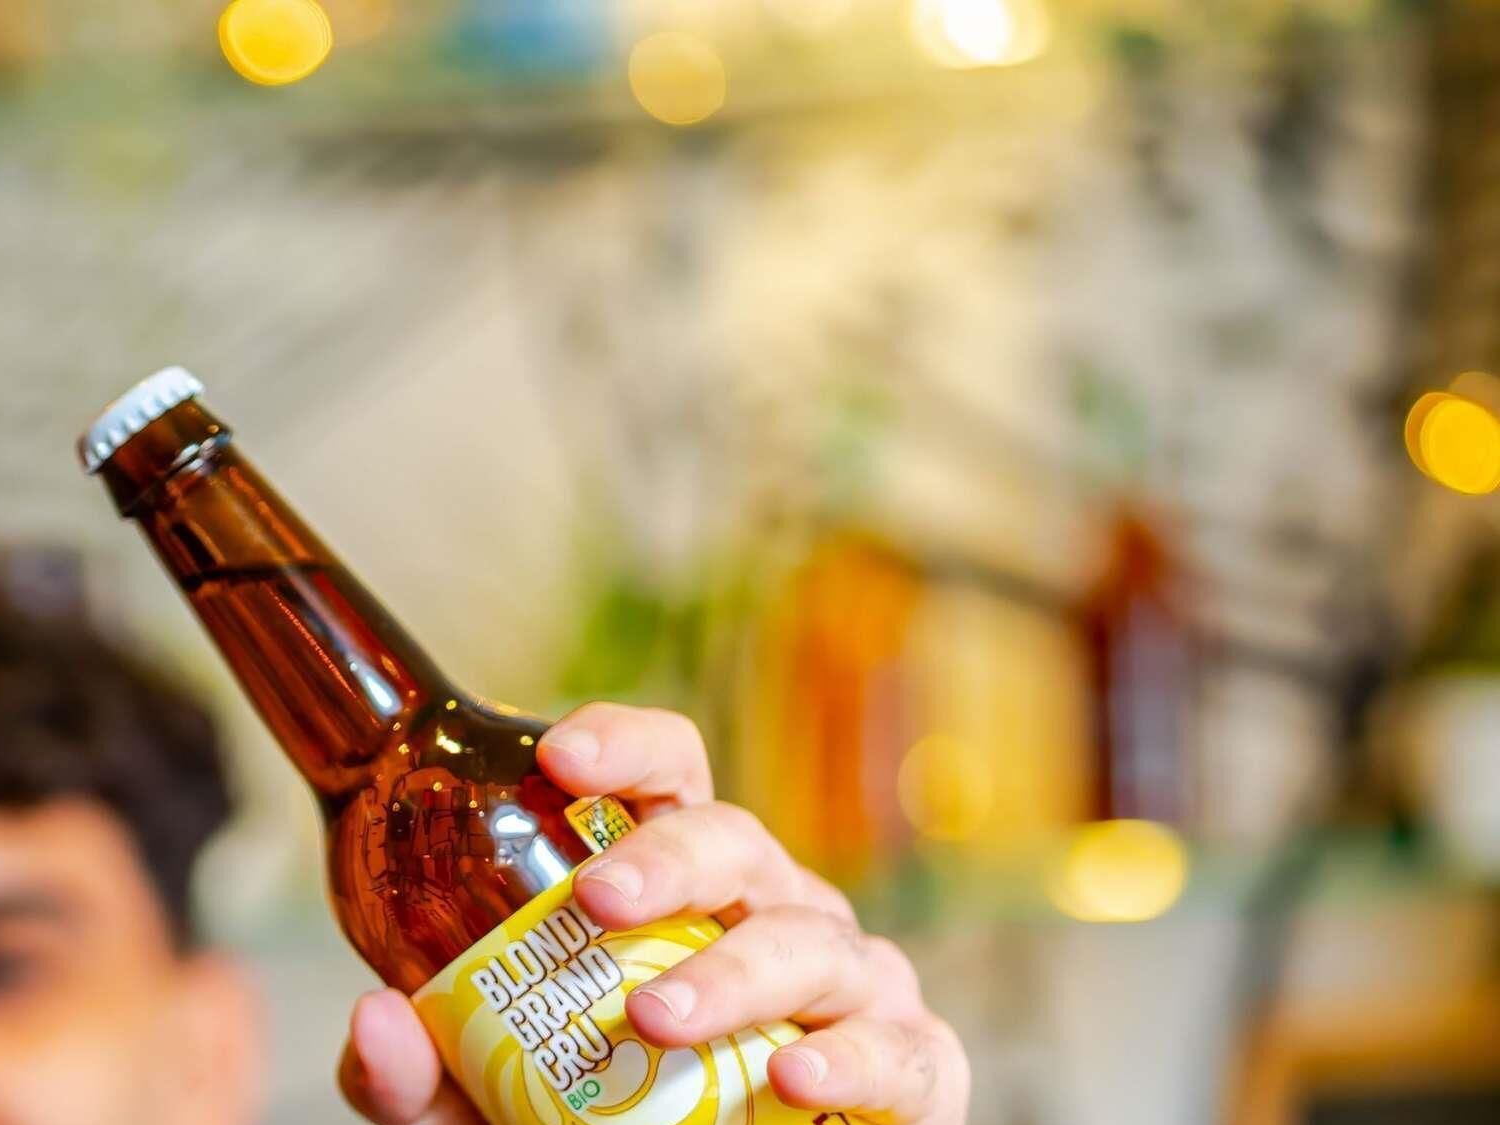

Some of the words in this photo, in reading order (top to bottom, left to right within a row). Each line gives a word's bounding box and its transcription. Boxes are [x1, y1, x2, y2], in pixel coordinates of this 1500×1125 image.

[593, 815, 629, 850] BEE
[502, 944, 624, 1051] GRAND
[532, 1013, 613, 1092] CRU
[567, 1079, 601, 1111] BIO
